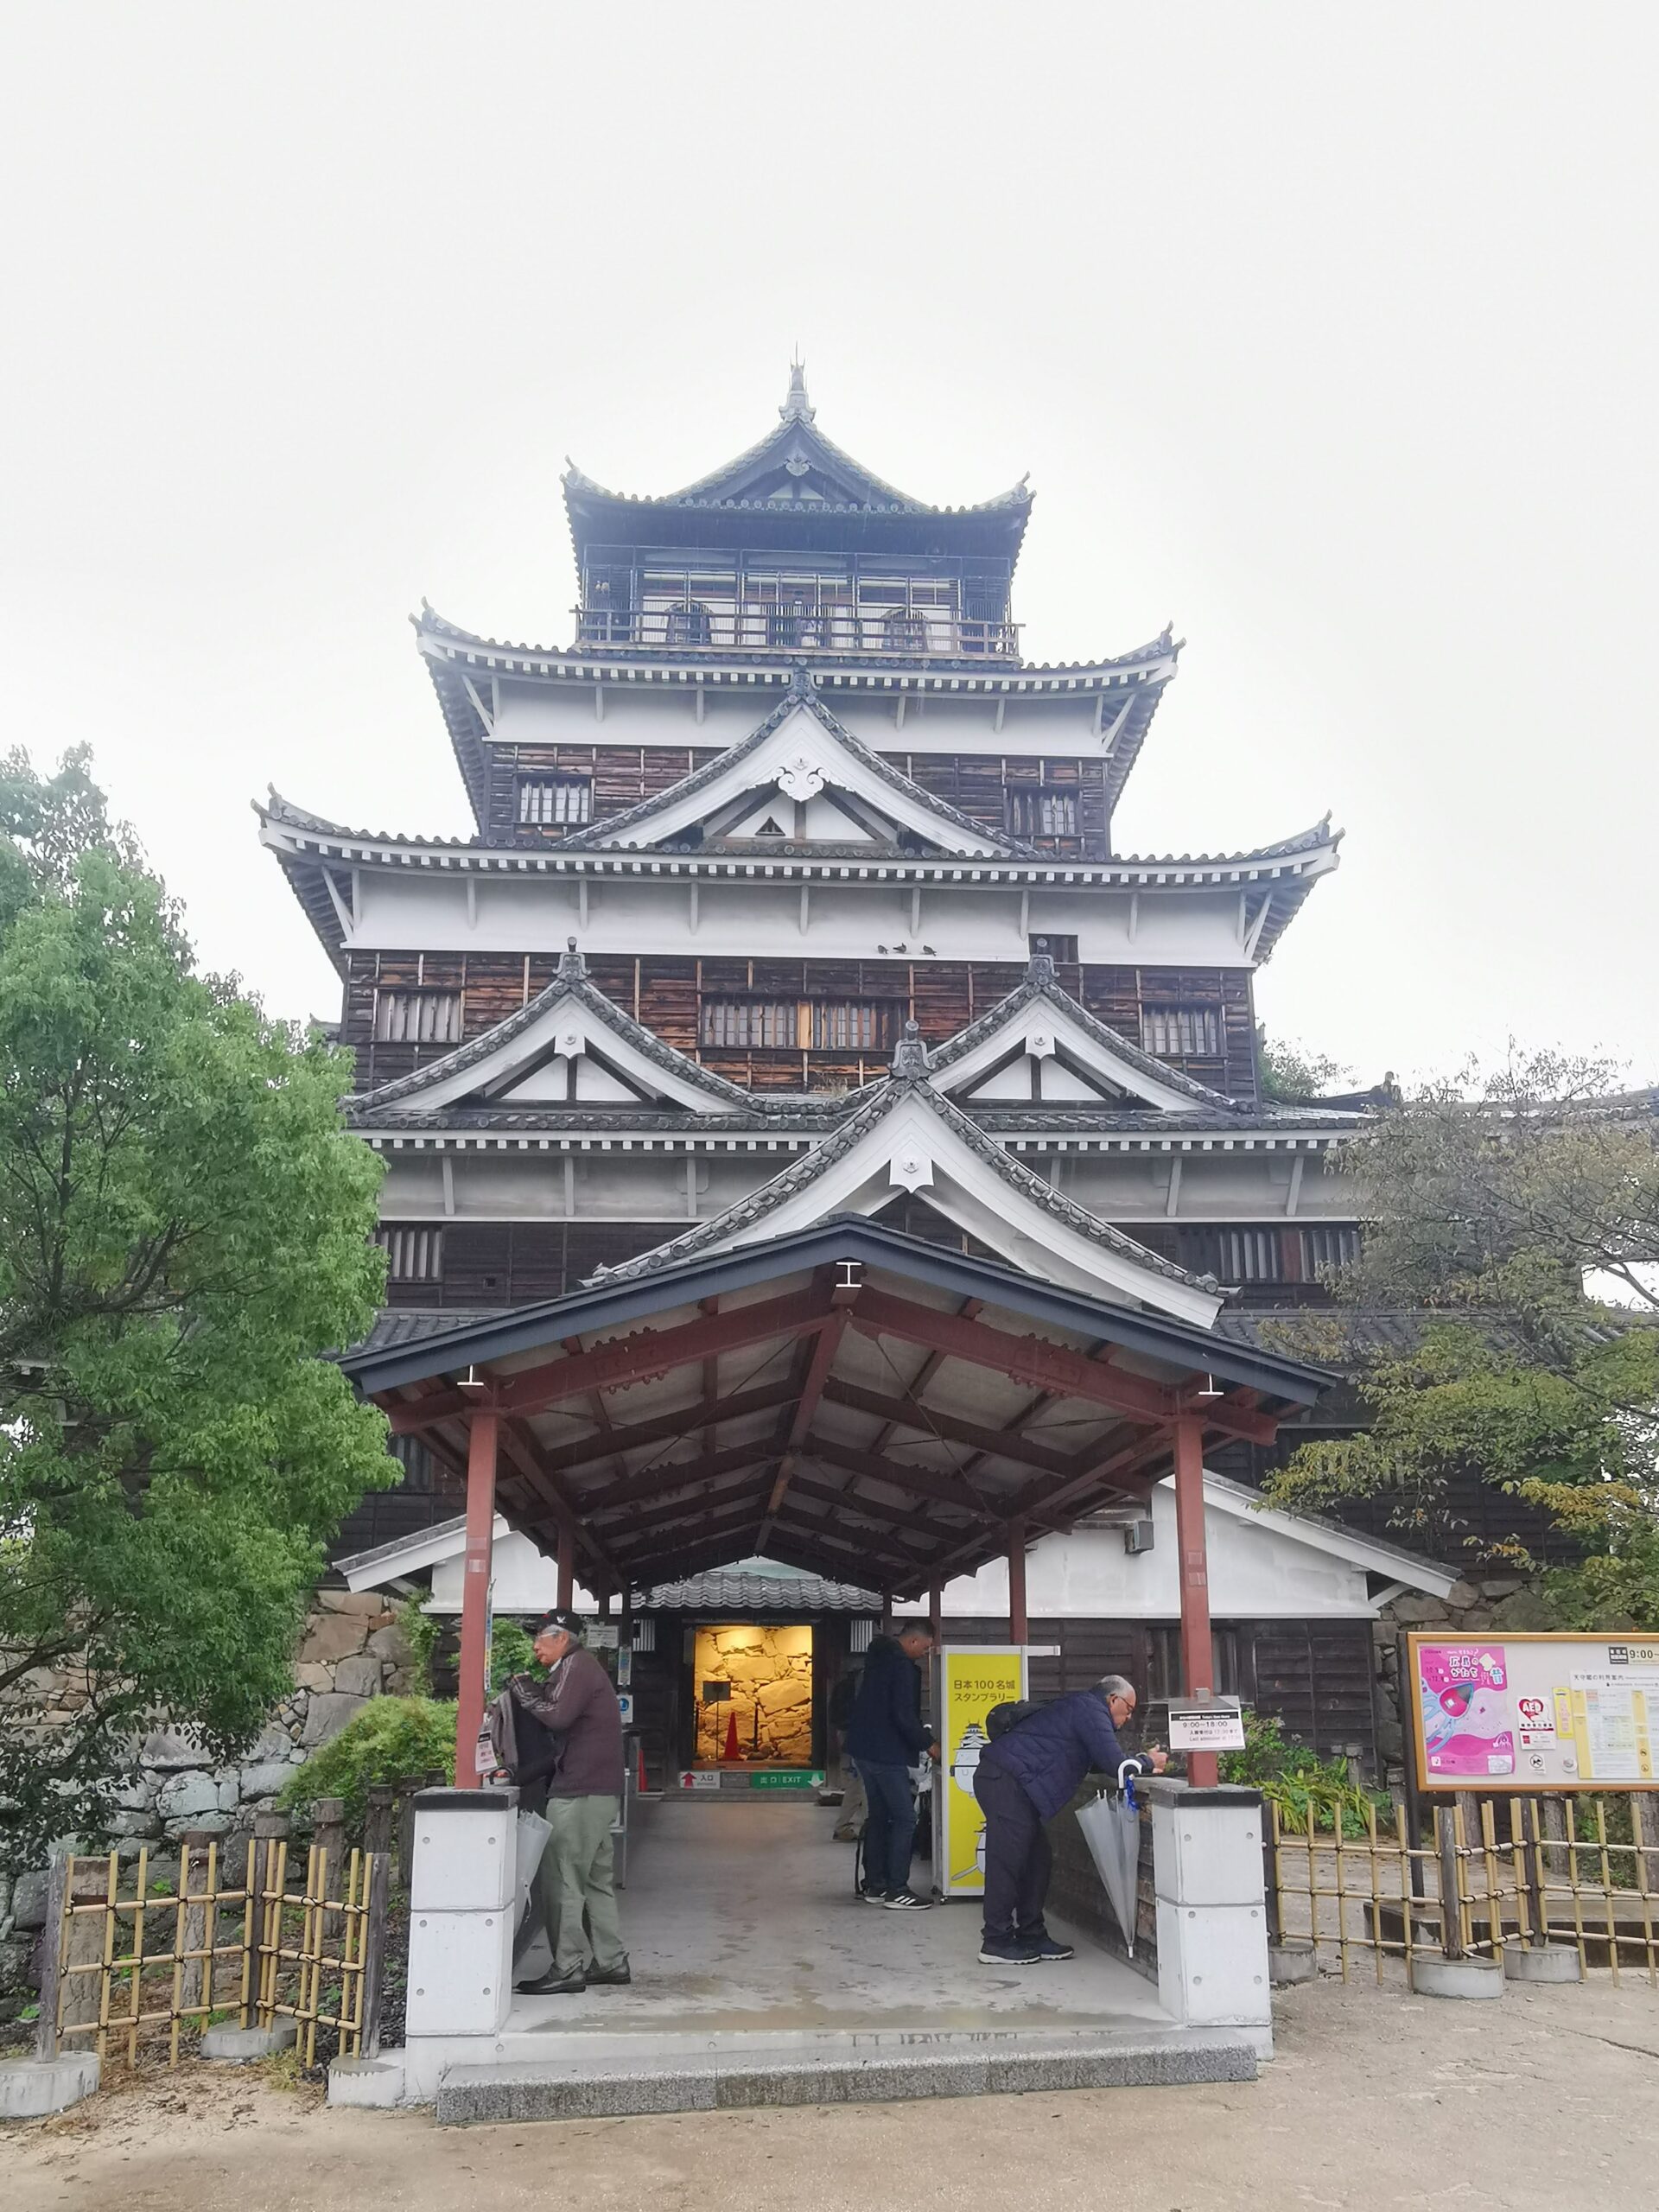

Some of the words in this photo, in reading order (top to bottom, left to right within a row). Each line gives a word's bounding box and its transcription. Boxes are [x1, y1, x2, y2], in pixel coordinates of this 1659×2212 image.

[954, 1680, 1015, 1690] 日本100名城
[954, 1693, 1015, 1702] スタンプラリー
[1522, 1701, 1542, 1713] AED
